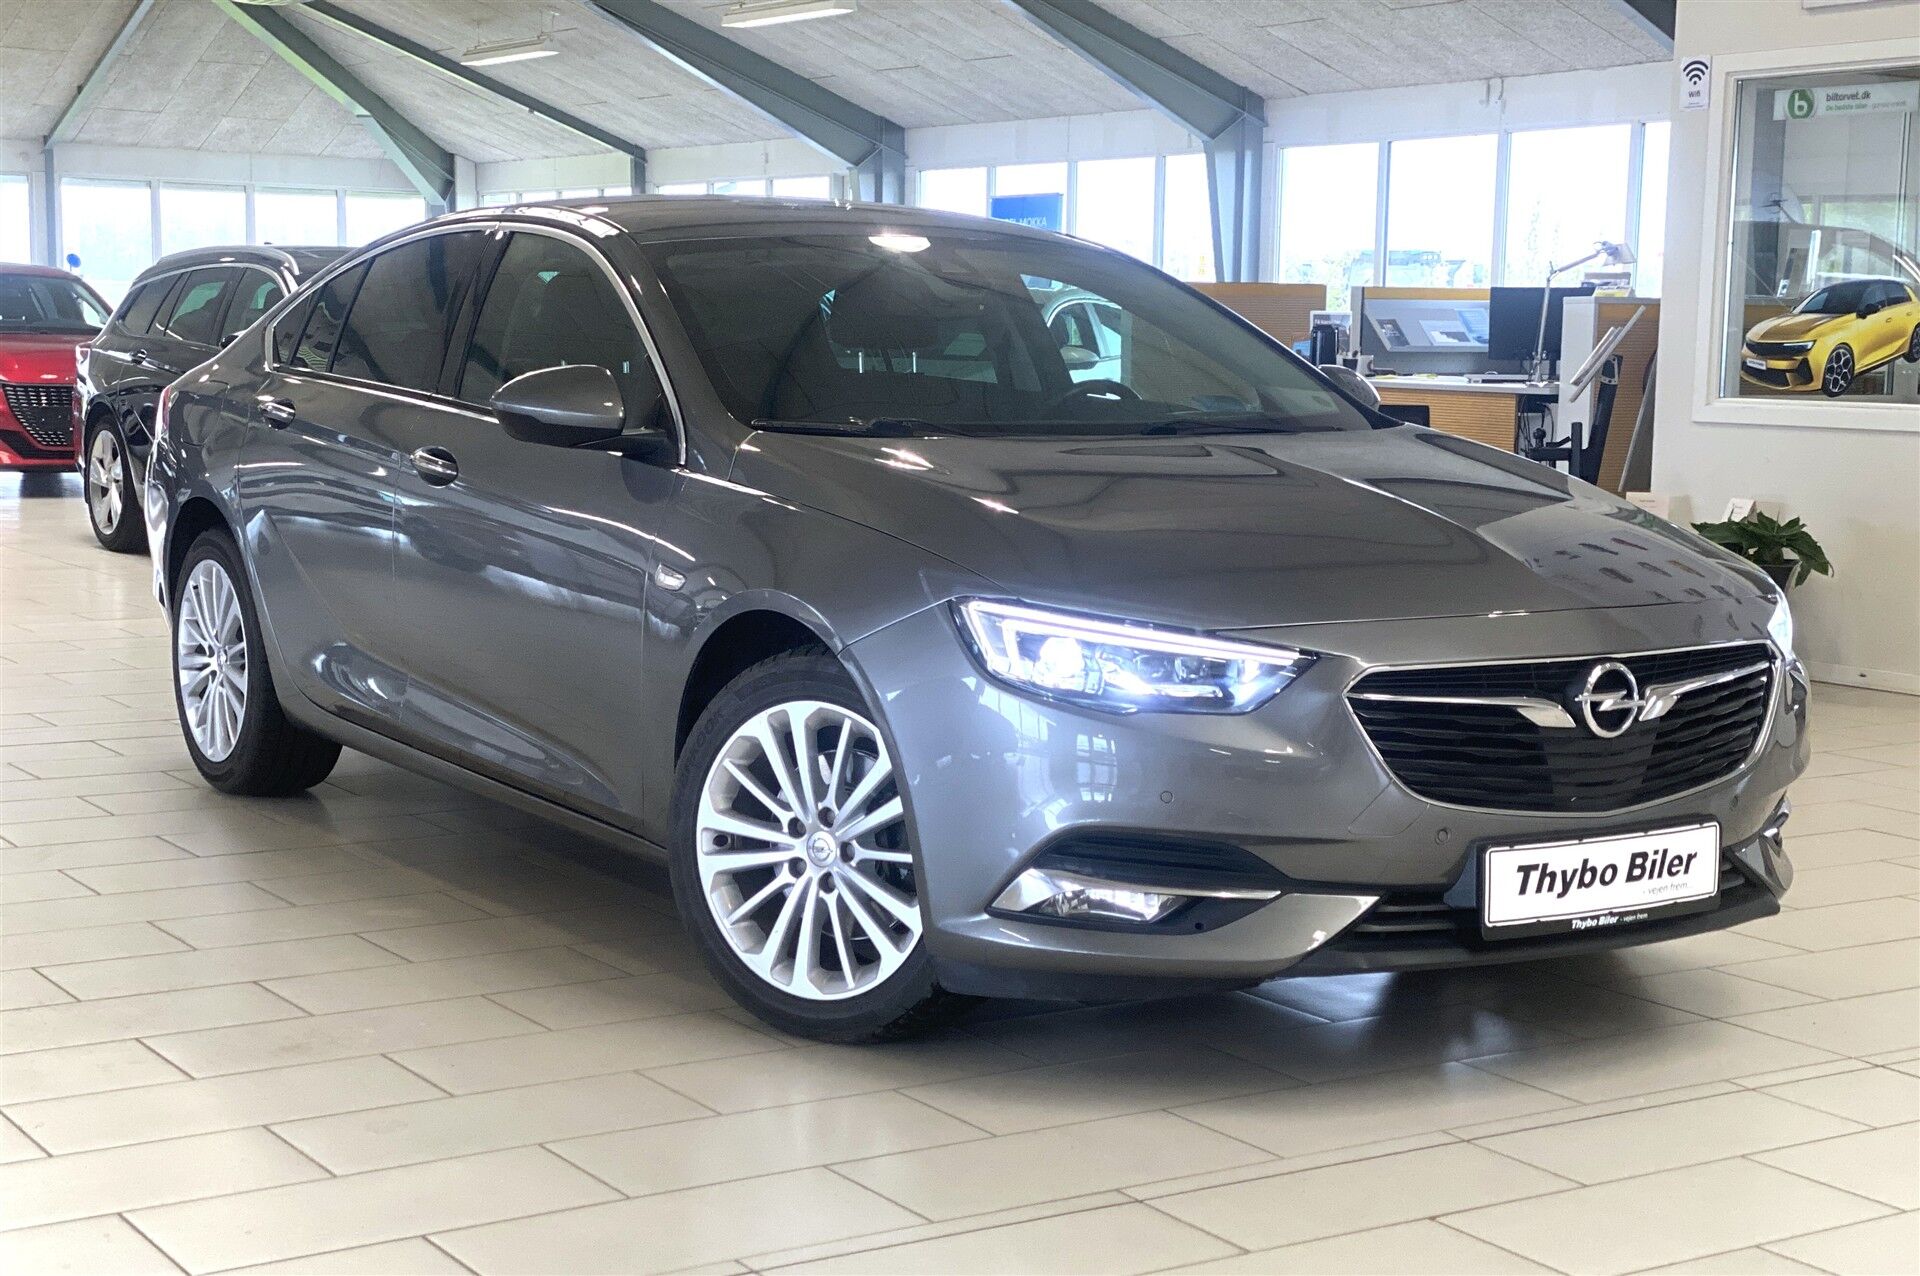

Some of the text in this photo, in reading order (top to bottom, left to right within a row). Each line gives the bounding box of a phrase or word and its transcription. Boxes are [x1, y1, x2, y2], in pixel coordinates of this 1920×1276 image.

[1516, 848, 1698, 899] Thybo Biler
[1571, 918, 1598, 930] Thybo
[1598, 915, 1619, 926] Biler
